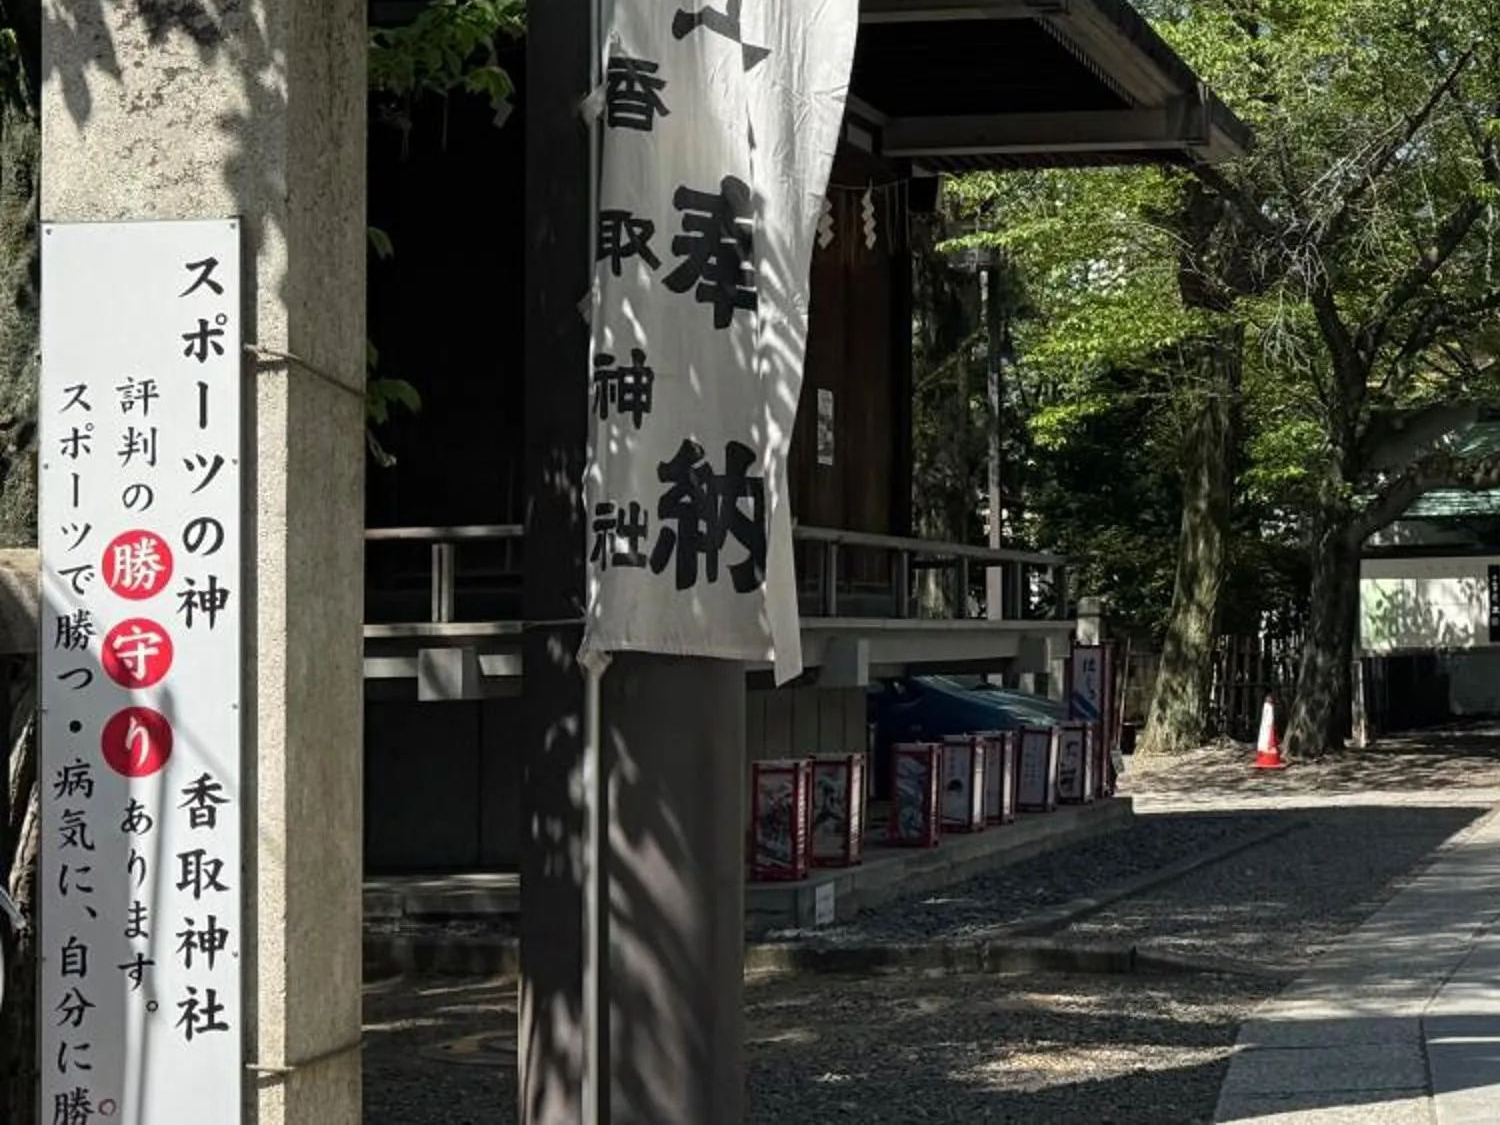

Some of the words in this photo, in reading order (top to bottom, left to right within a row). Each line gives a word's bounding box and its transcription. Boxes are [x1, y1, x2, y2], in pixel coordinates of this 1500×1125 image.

[176, 256, 230, 630] スポーツの神
[177, 772, 230, 1041] 香取神社
